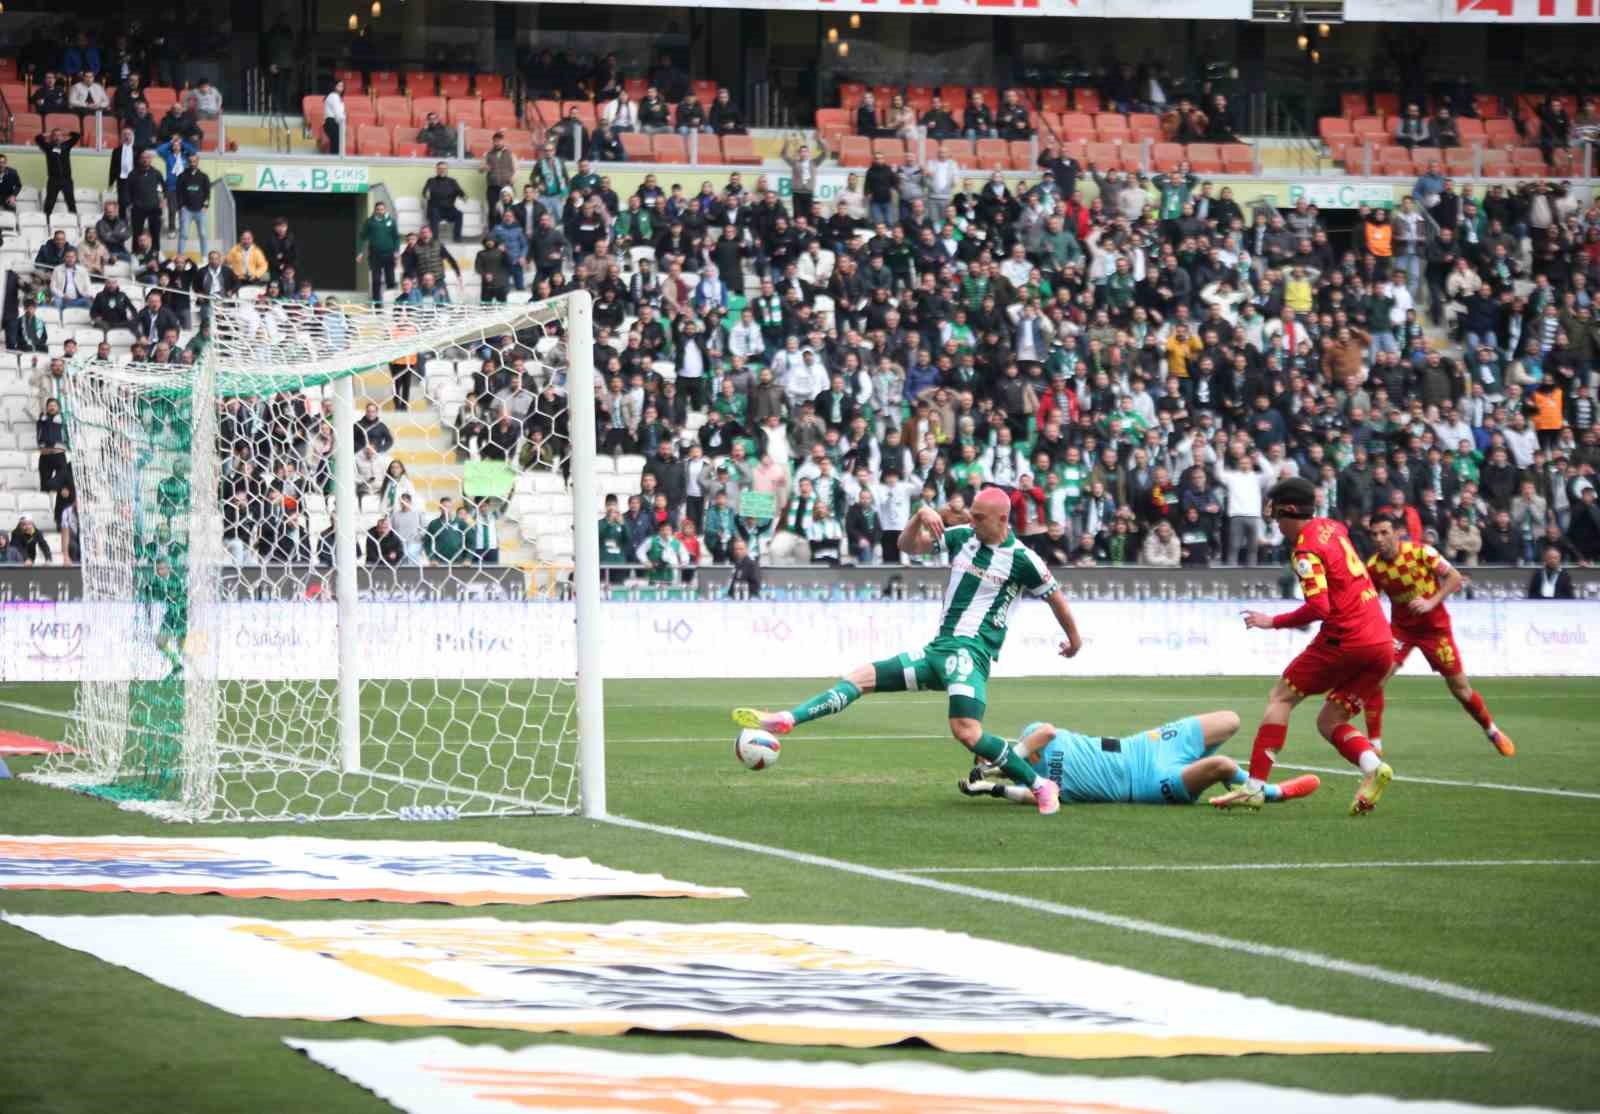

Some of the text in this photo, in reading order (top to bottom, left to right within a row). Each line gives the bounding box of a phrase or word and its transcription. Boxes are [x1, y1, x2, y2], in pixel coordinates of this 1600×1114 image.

[258, 167, 329, 190] A B
[778, 177, 792, 196] B
[1339, 186, 1354, 206] C
